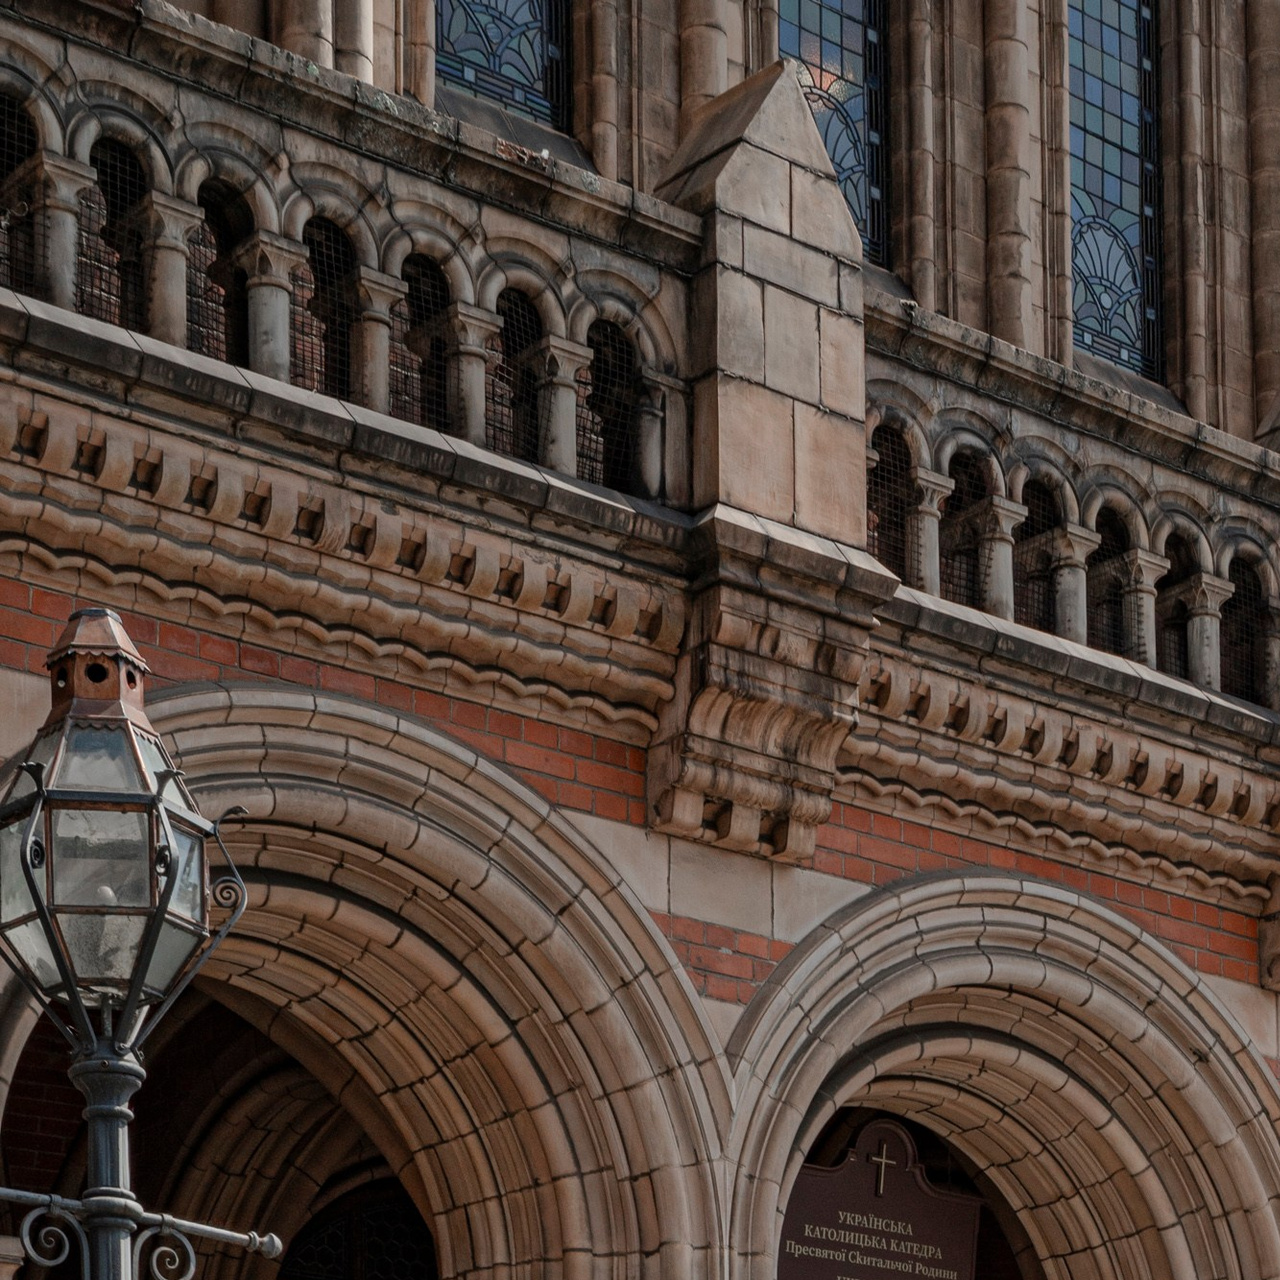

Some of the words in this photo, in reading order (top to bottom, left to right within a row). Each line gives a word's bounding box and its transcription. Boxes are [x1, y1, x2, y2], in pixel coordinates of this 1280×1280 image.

[838, 1210, 913, 1236] УКРАЇНСЬКА
[785, 1240, 846, 1262] Пресвятої
[915, 1262, 958, 1280] Родини
[804, 1224, 887, 1251] КАТОЛИЦЬКА
[890, 1238, 943, 1260] КАТЕДРА
